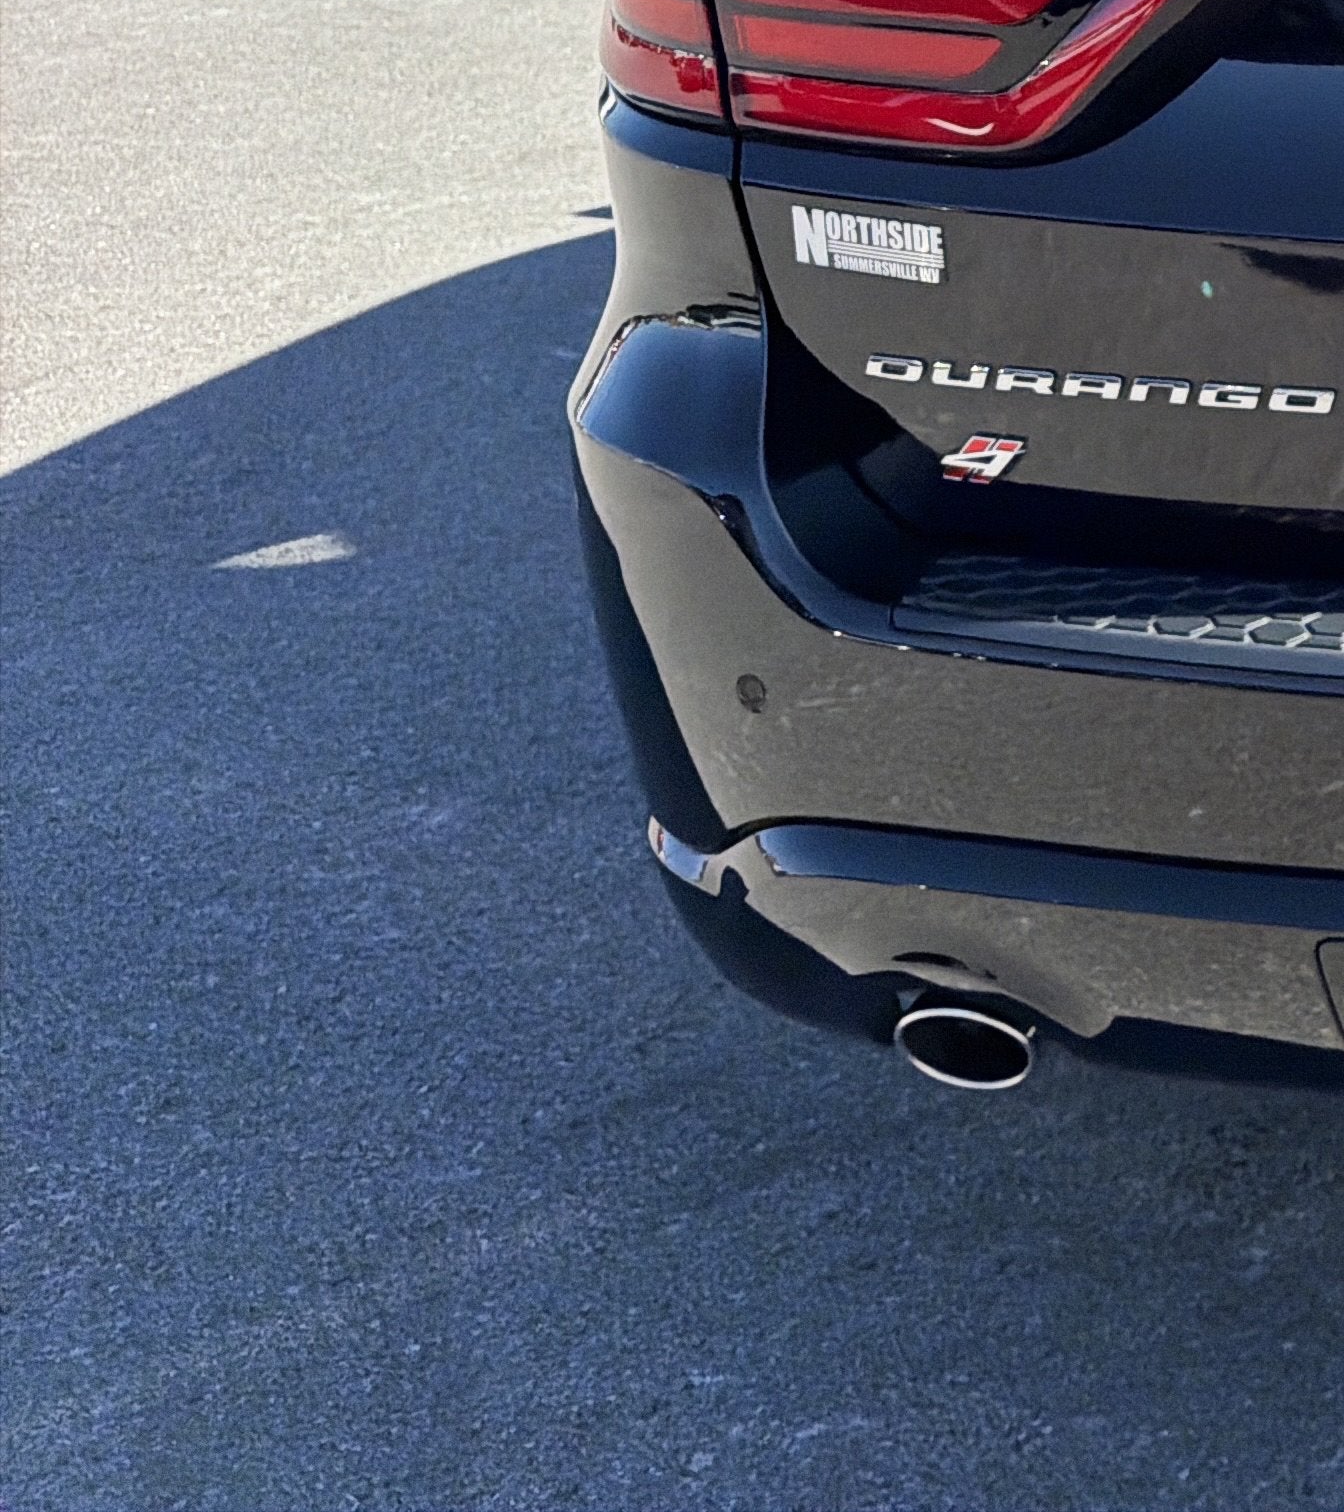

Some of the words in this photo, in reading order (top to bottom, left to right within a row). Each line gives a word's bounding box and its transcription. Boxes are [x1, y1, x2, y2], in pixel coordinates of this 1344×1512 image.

[791, 205, 944, 267] NORTHSIDE
[833, 253, 919, 281] SUMMERSVILLE
[919, 266, 940, 284] WV
[865, 353, 1336, 414] DURANGO
